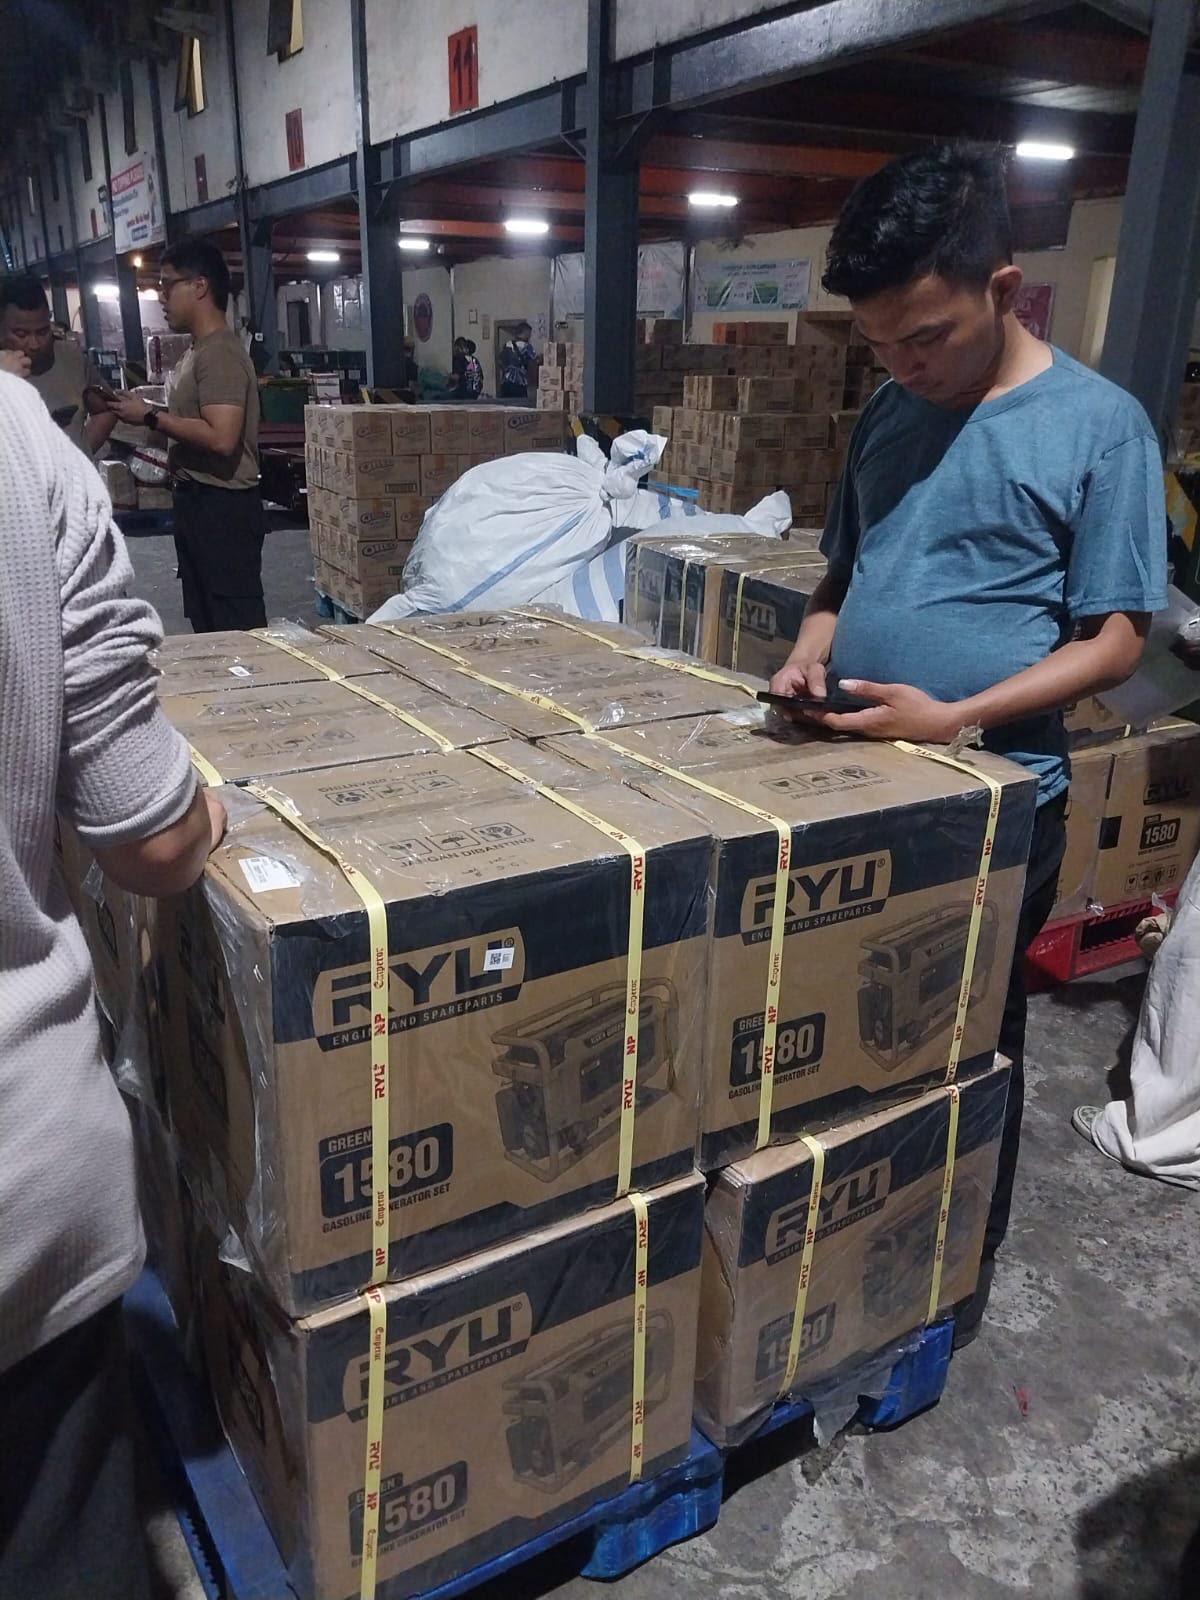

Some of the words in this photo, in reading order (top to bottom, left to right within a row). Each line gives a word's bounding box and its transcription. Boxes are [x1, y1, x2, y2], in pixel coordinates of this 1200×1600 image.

[453, 35, 473, 105] 11
[984, 838, 991, 855] NP
[1145, 822, 1176, 845] 1580
[780, 838, 788, 870] RYU
[633, 856, 643, 890] RYU
[754, 859, 877, 925] RYU
[791, 920, 810, 932] AND
[814, 904, 872, 926] SPAREPARTS
[331, 938, 503, 1027] RYU
[374, 1013, 386, 1035] NP
[391, 1015, 416, 1031] AND
[423, 991, 504, 1022] SPAREPARTS
[739, 1015, 765, 1031] GREE
[768, 1005, 776, 1024] NP
[627, 1036, 636, 1055] NP
[764, 1046, 773, 1074] RYU
[807, 1063, 820, 1076] SET
[374, 1064, 385, 1099] RYU
[623, 1079, 633, 1110] RYU
[388, 1190, 432, 1212] NERATOR
[433, 1182, 451, 1197] SET
[375, 1247, 385, 1267] NP
[638, 1269, 645, 1287] NP
[359, 1305, 511, 1401] RYU
[366, 1492, 377, 1511] NP
[383, 1474, 456, 1534] 580
